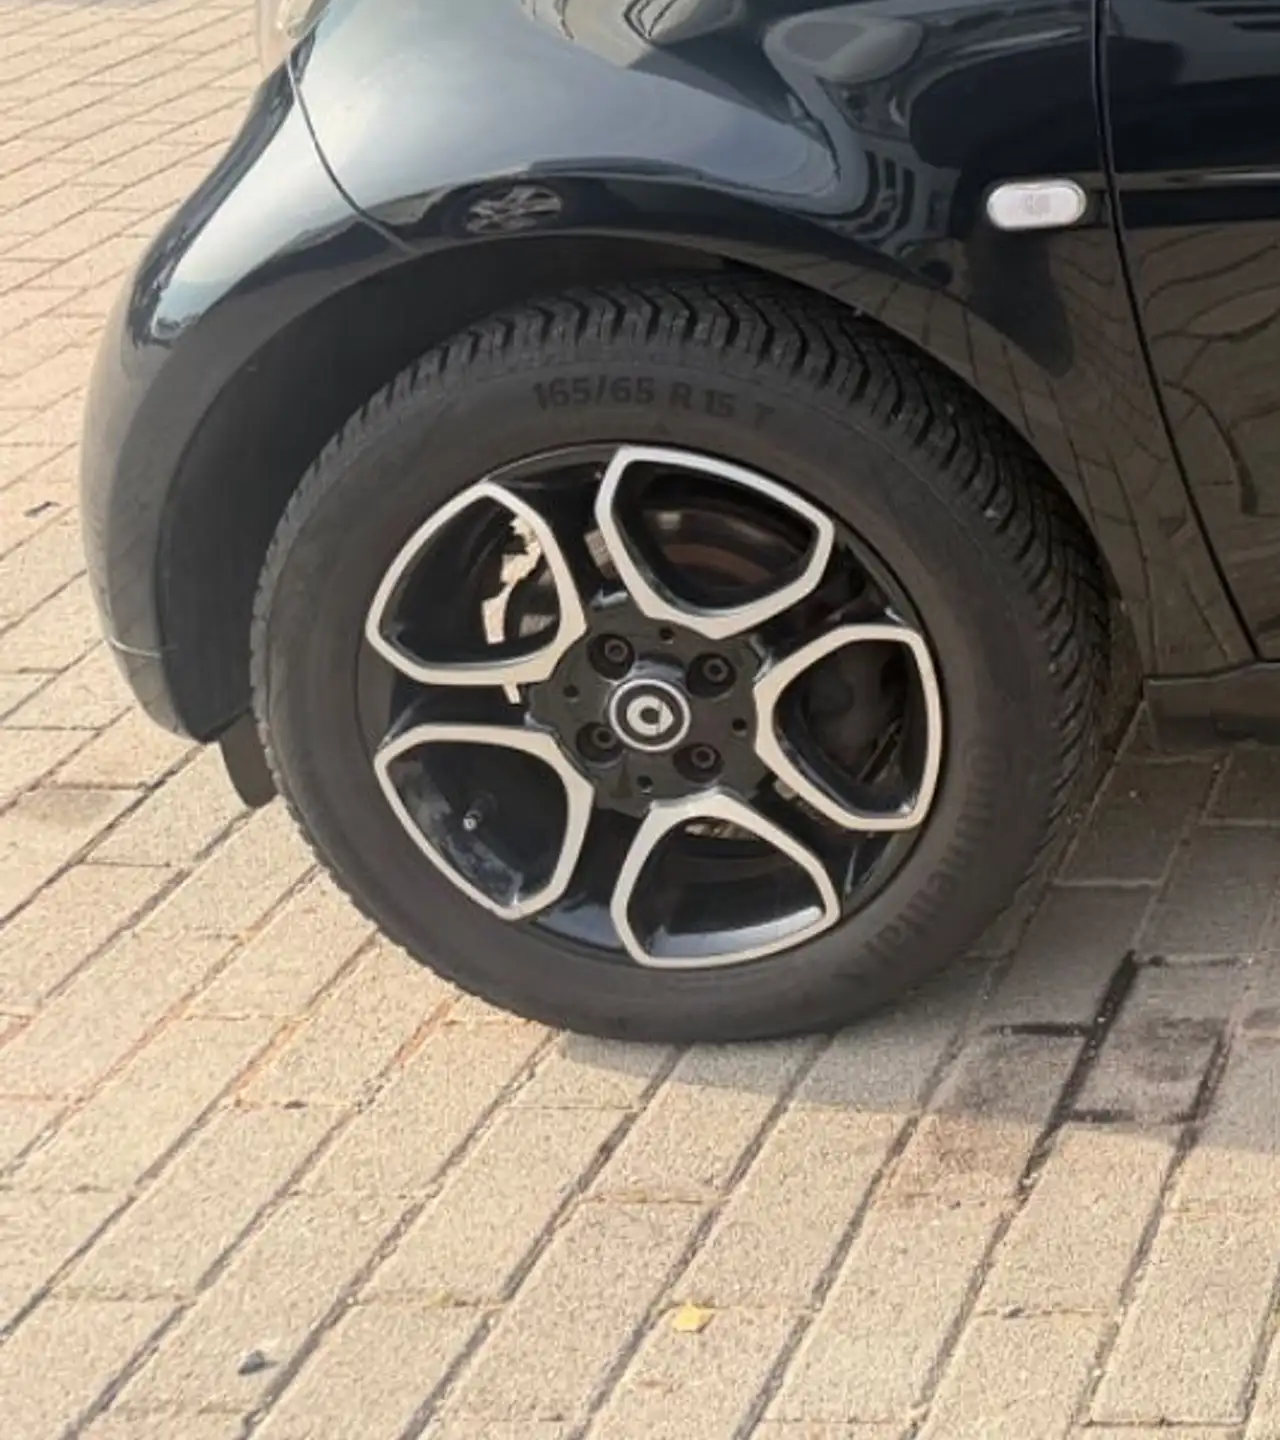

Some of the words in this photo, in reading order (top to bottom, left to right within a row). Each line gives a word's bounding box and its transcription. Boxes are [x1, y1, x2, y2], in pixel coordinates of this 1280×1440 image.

[532, 375, 656, 411] 165/65
[669, 381, 693, 410] R
[702, 389, 737, 418] 15
